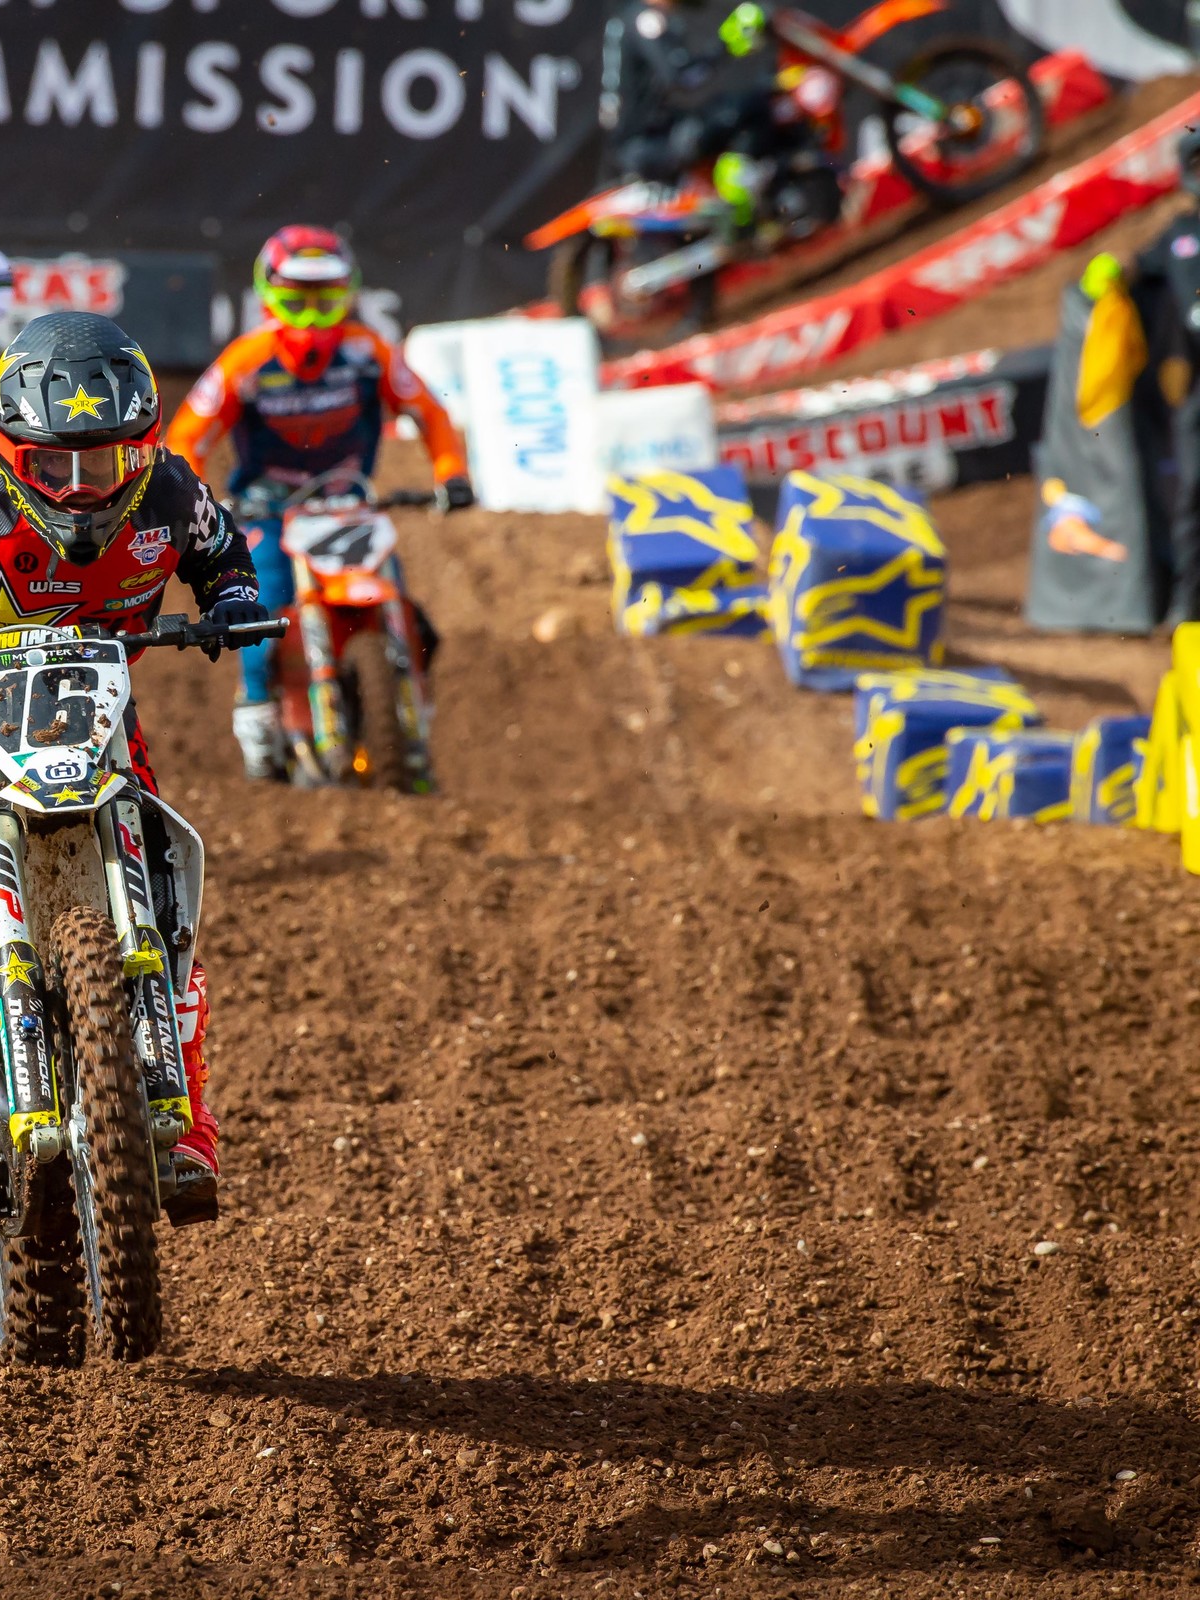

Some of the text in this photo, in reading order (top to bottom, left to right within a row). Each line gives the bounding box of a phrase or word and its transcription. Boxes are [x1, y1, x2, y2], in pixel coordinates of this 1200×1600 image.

[721, 395, 1003, 474] DISCOUNT
[30, 581, 81, 593] WPS
[120, 568, 164, 589] FMF
[7, 998, 32, 1102] DUNLOP
